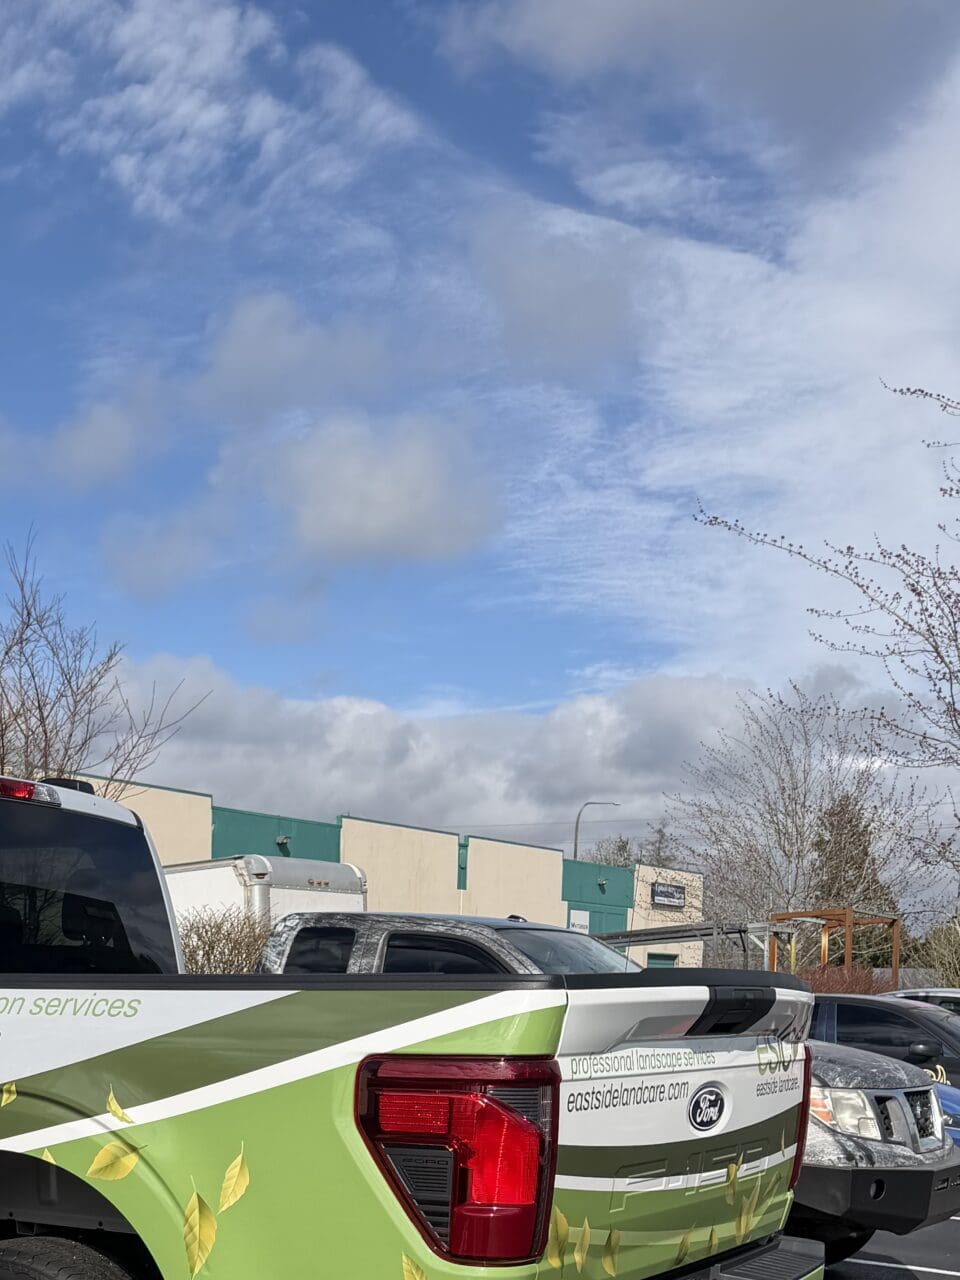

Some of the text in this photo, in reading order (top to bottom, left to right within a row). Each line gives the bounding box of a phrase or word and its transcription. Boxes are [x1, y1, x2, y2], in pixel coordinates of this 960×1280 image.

[29, 992, 142, 1018] services
[571, 1047, 716, 1081] professional landscape services
[567, 1080, 689, 1113] eastsidelandcare.com
[695, 1094, 721, 1123] Ford
